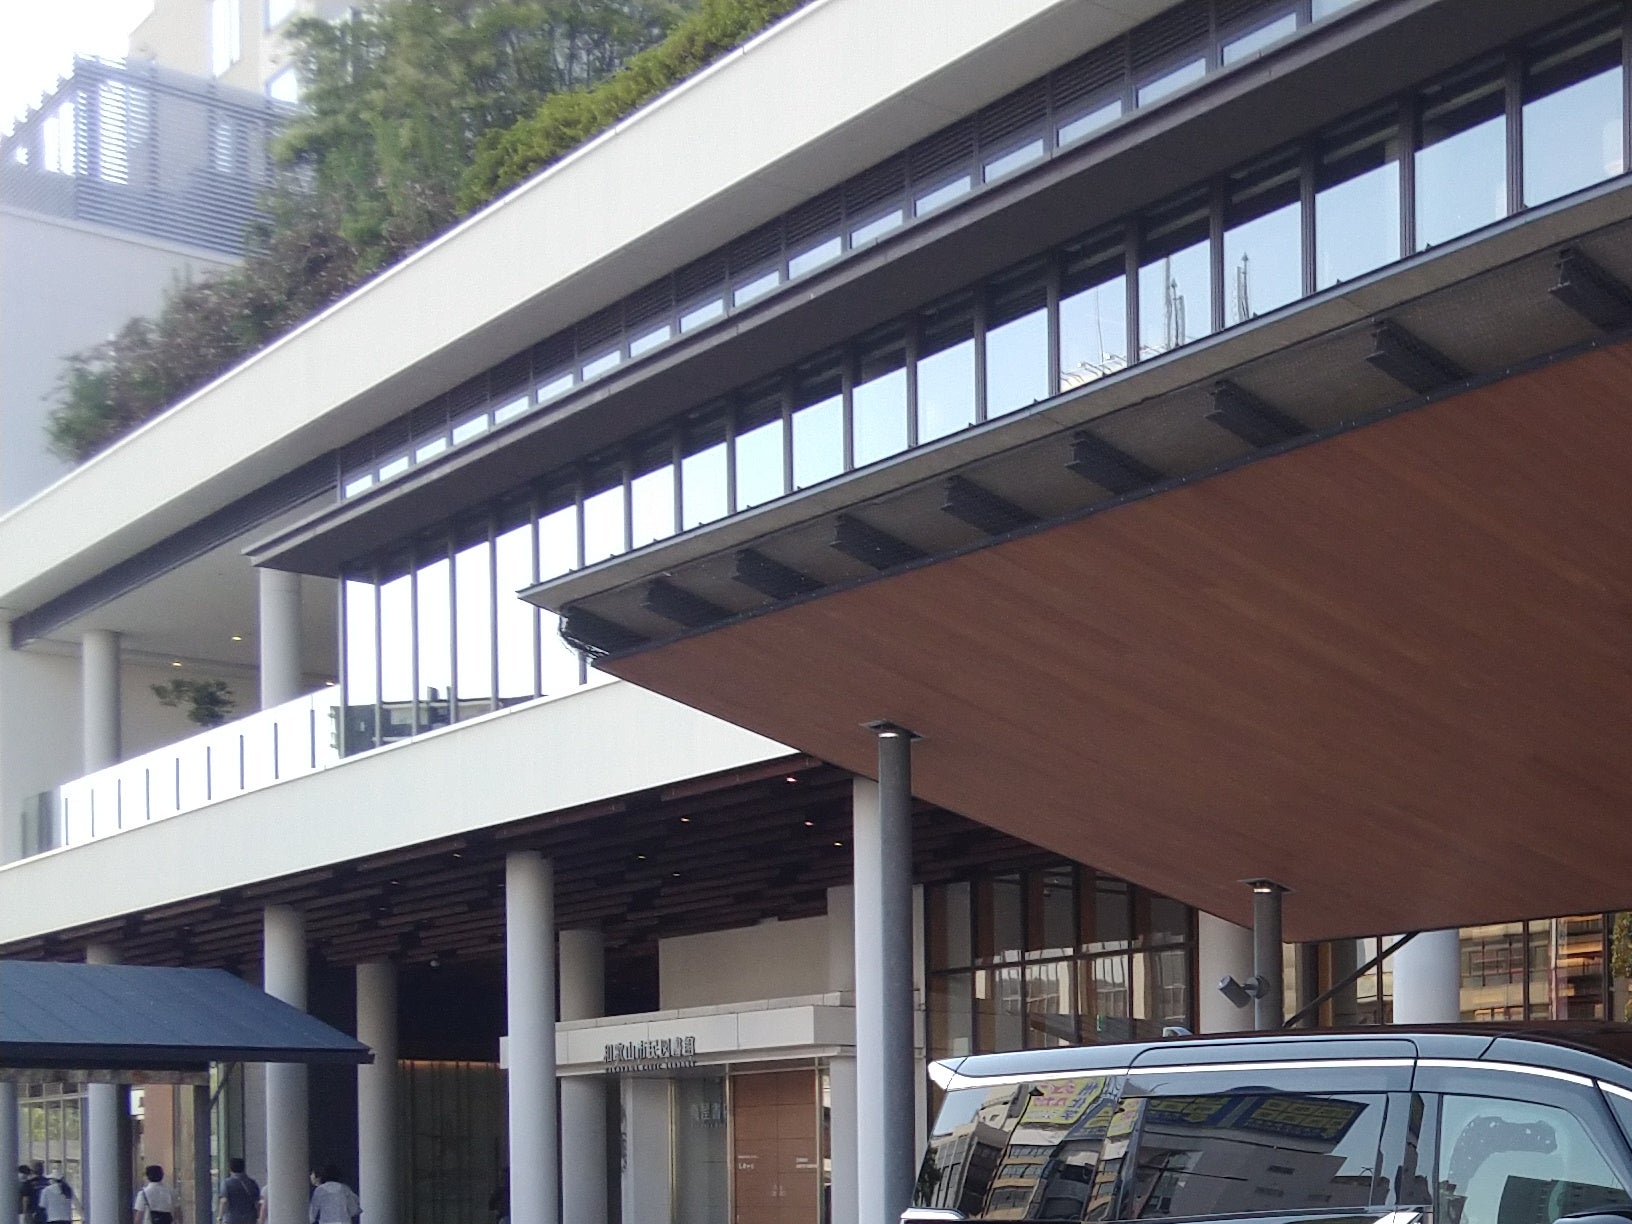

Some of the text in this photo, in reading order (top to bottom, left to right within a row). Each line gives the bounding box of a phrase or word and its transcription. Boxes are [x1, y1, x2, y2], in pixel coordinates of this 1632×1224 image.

[604, 1036, 696, 1062] 和歌山市民図書館
